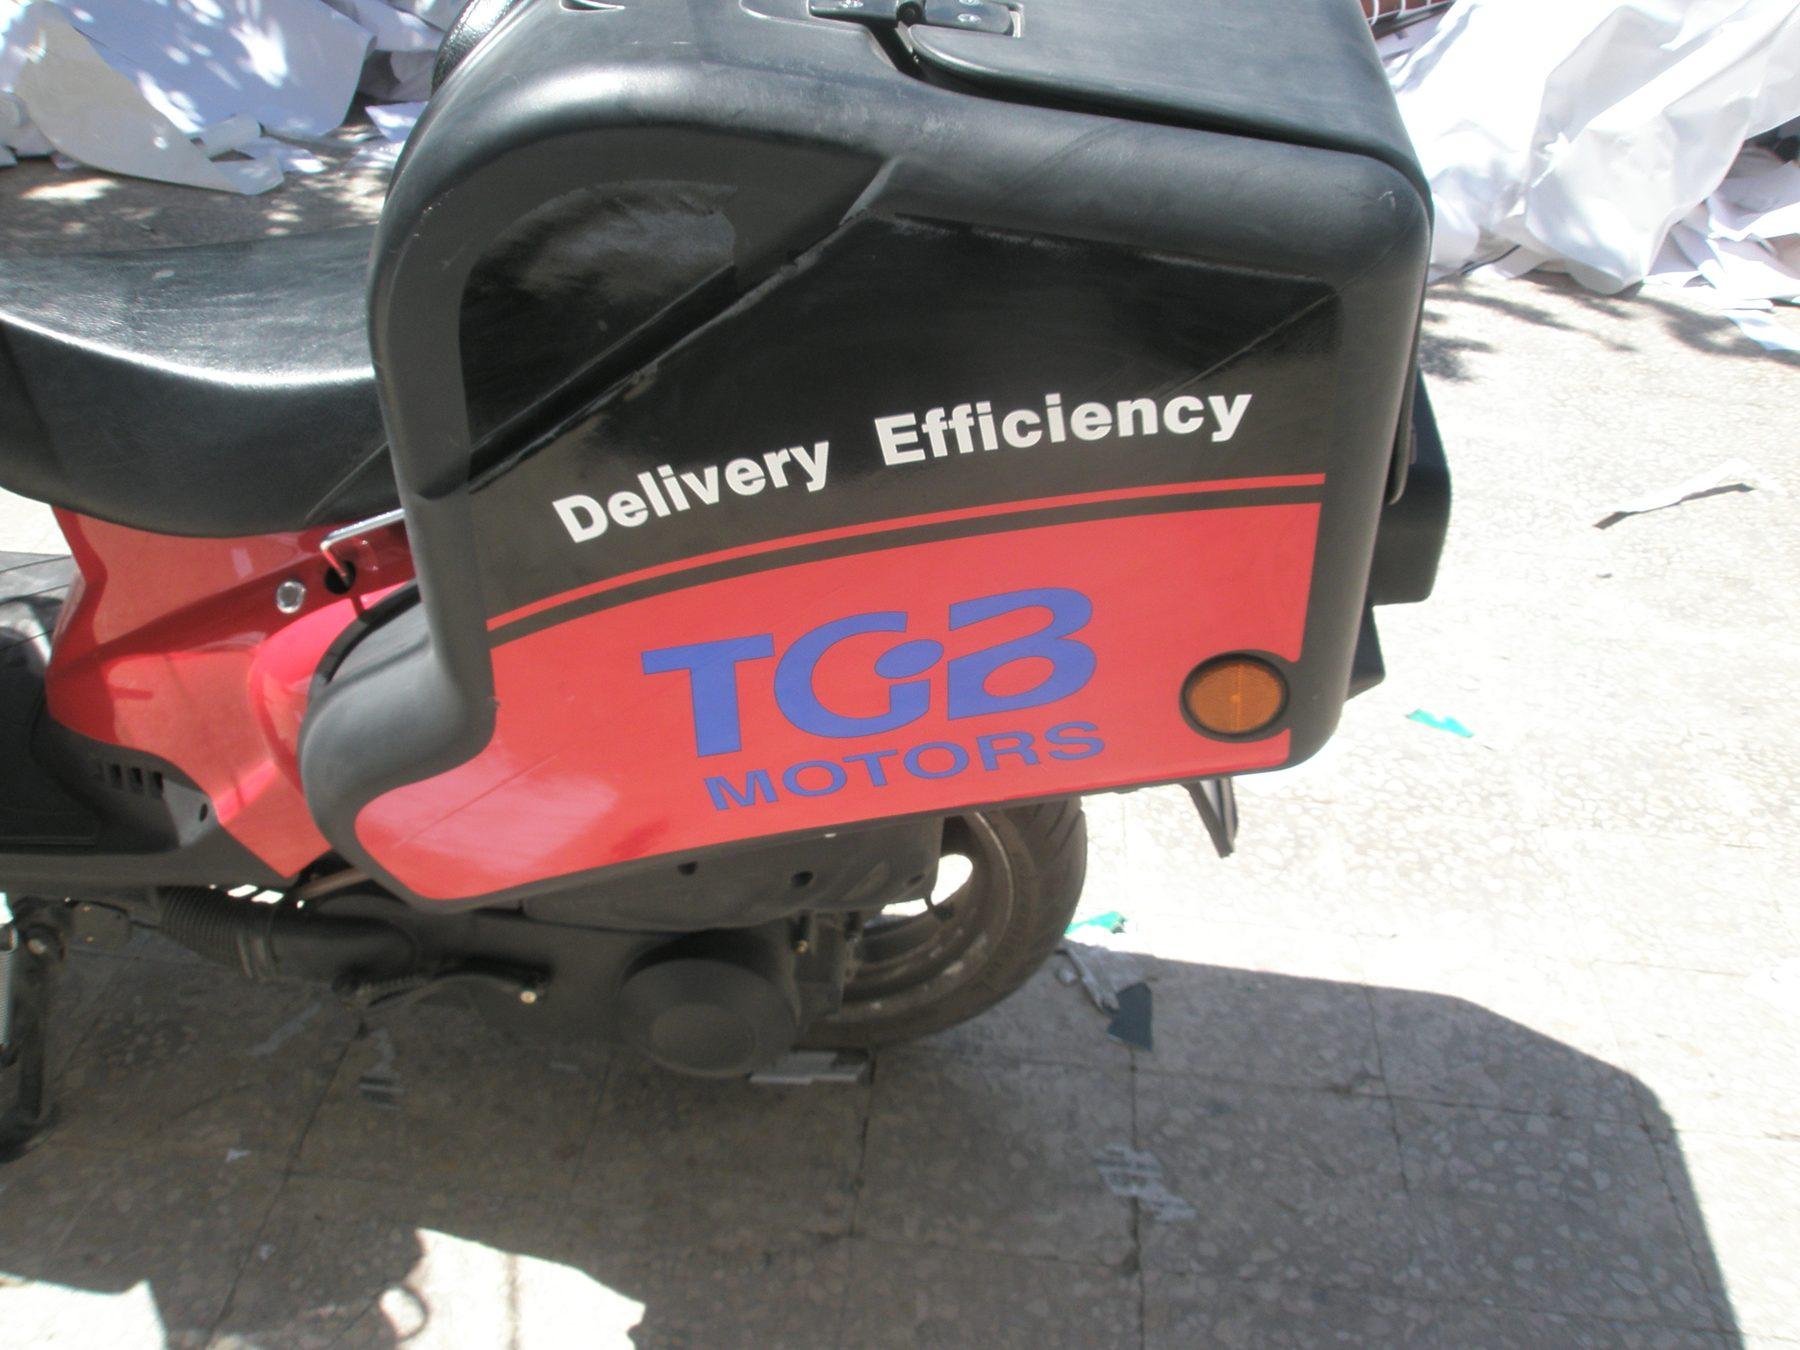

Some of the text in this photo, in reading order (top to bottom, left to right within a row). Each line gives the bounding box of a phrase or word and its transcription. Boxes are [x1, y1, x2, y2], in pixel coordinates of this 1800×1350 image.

[552, 392, 1254, 545] Delivery Efficiency
[641, 587, 1097, 758] TGB
[704, 720, 1106, 811] MOTORS
